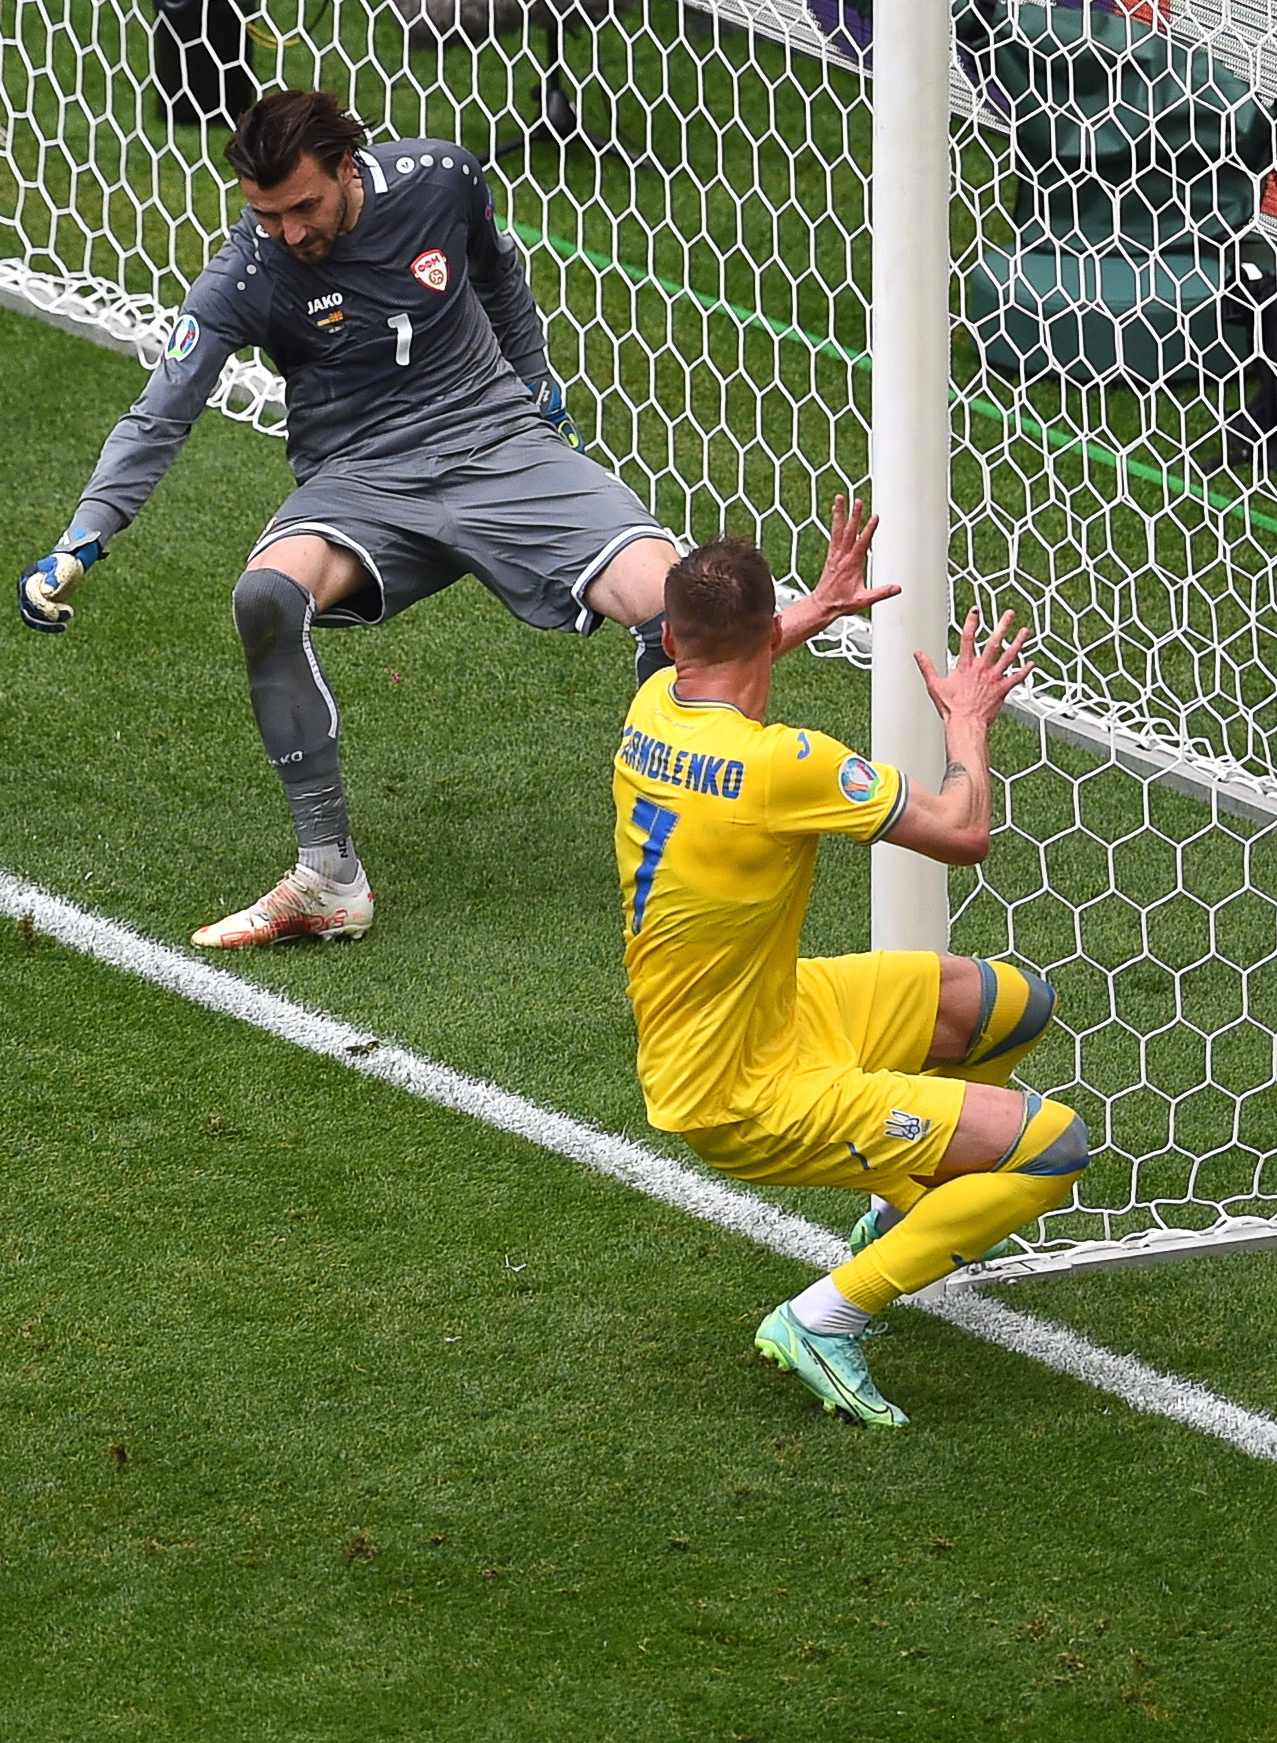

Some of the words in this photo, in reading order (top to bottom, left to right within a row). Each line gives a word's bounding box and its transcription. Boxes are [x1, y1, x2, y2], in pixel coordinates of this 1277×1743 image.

[307, 292, 343, 315] JAKO
[387, 312, 413, 366] 1
[621, 724, 744, 799] ARMOLENKO
[630, 796, 680, 936] 7
